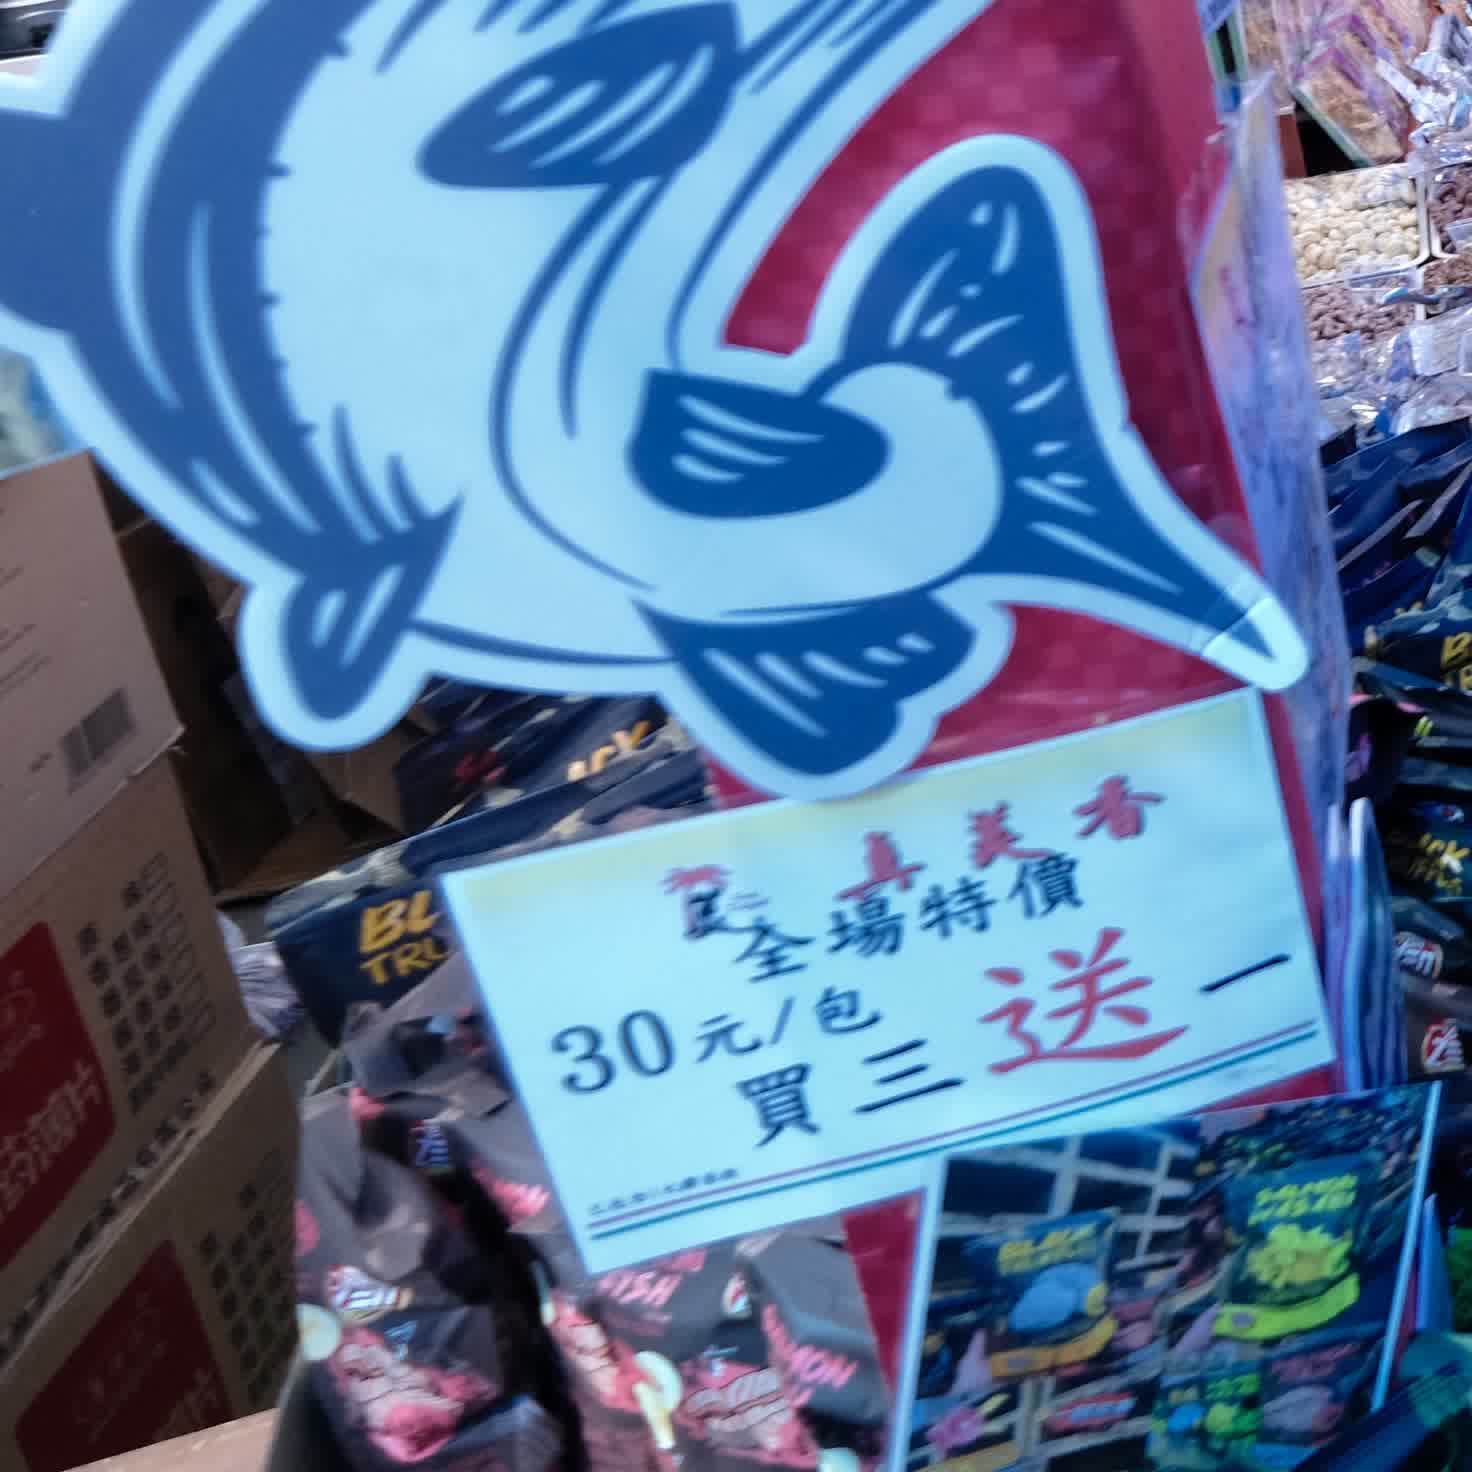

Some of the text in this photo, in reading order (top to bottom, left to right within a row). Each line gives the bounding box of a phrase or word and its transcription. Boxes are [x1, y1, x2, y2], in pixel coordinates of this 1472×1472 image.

[733, 852, 1083, 983] 全場特價
[551, 985, 883, 1094] 30元/包
[735, 929, 1290, 1148] 買三送一
